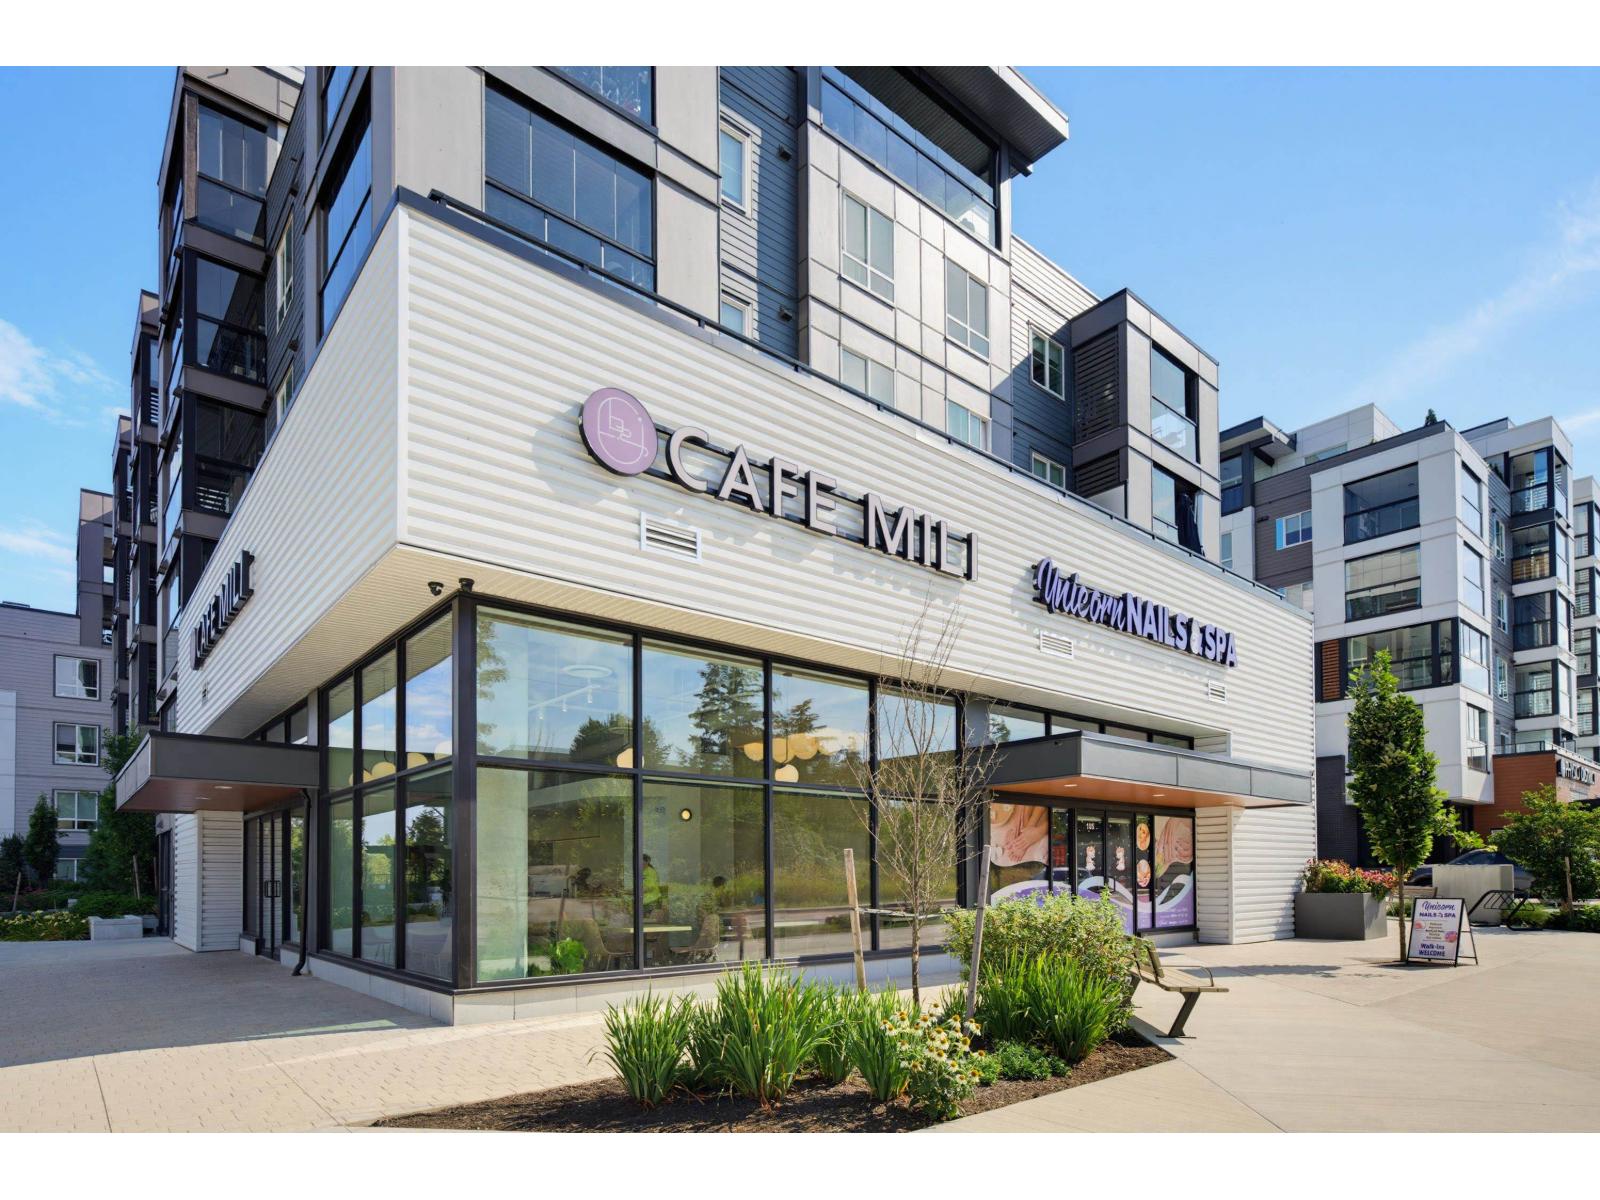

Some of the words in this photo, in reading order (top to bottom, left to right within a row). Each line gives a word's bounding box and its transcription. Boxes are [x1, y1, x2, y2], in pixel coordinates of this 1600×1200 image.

[665, 426, 837, 536] CAFE
[863, 493, 978, 581] MILI
[1035, 557, 1126, 632] Unicorn
[1122, 593, 1188, 651] NAILS
[1203, 624, 1238, 667] SPA
